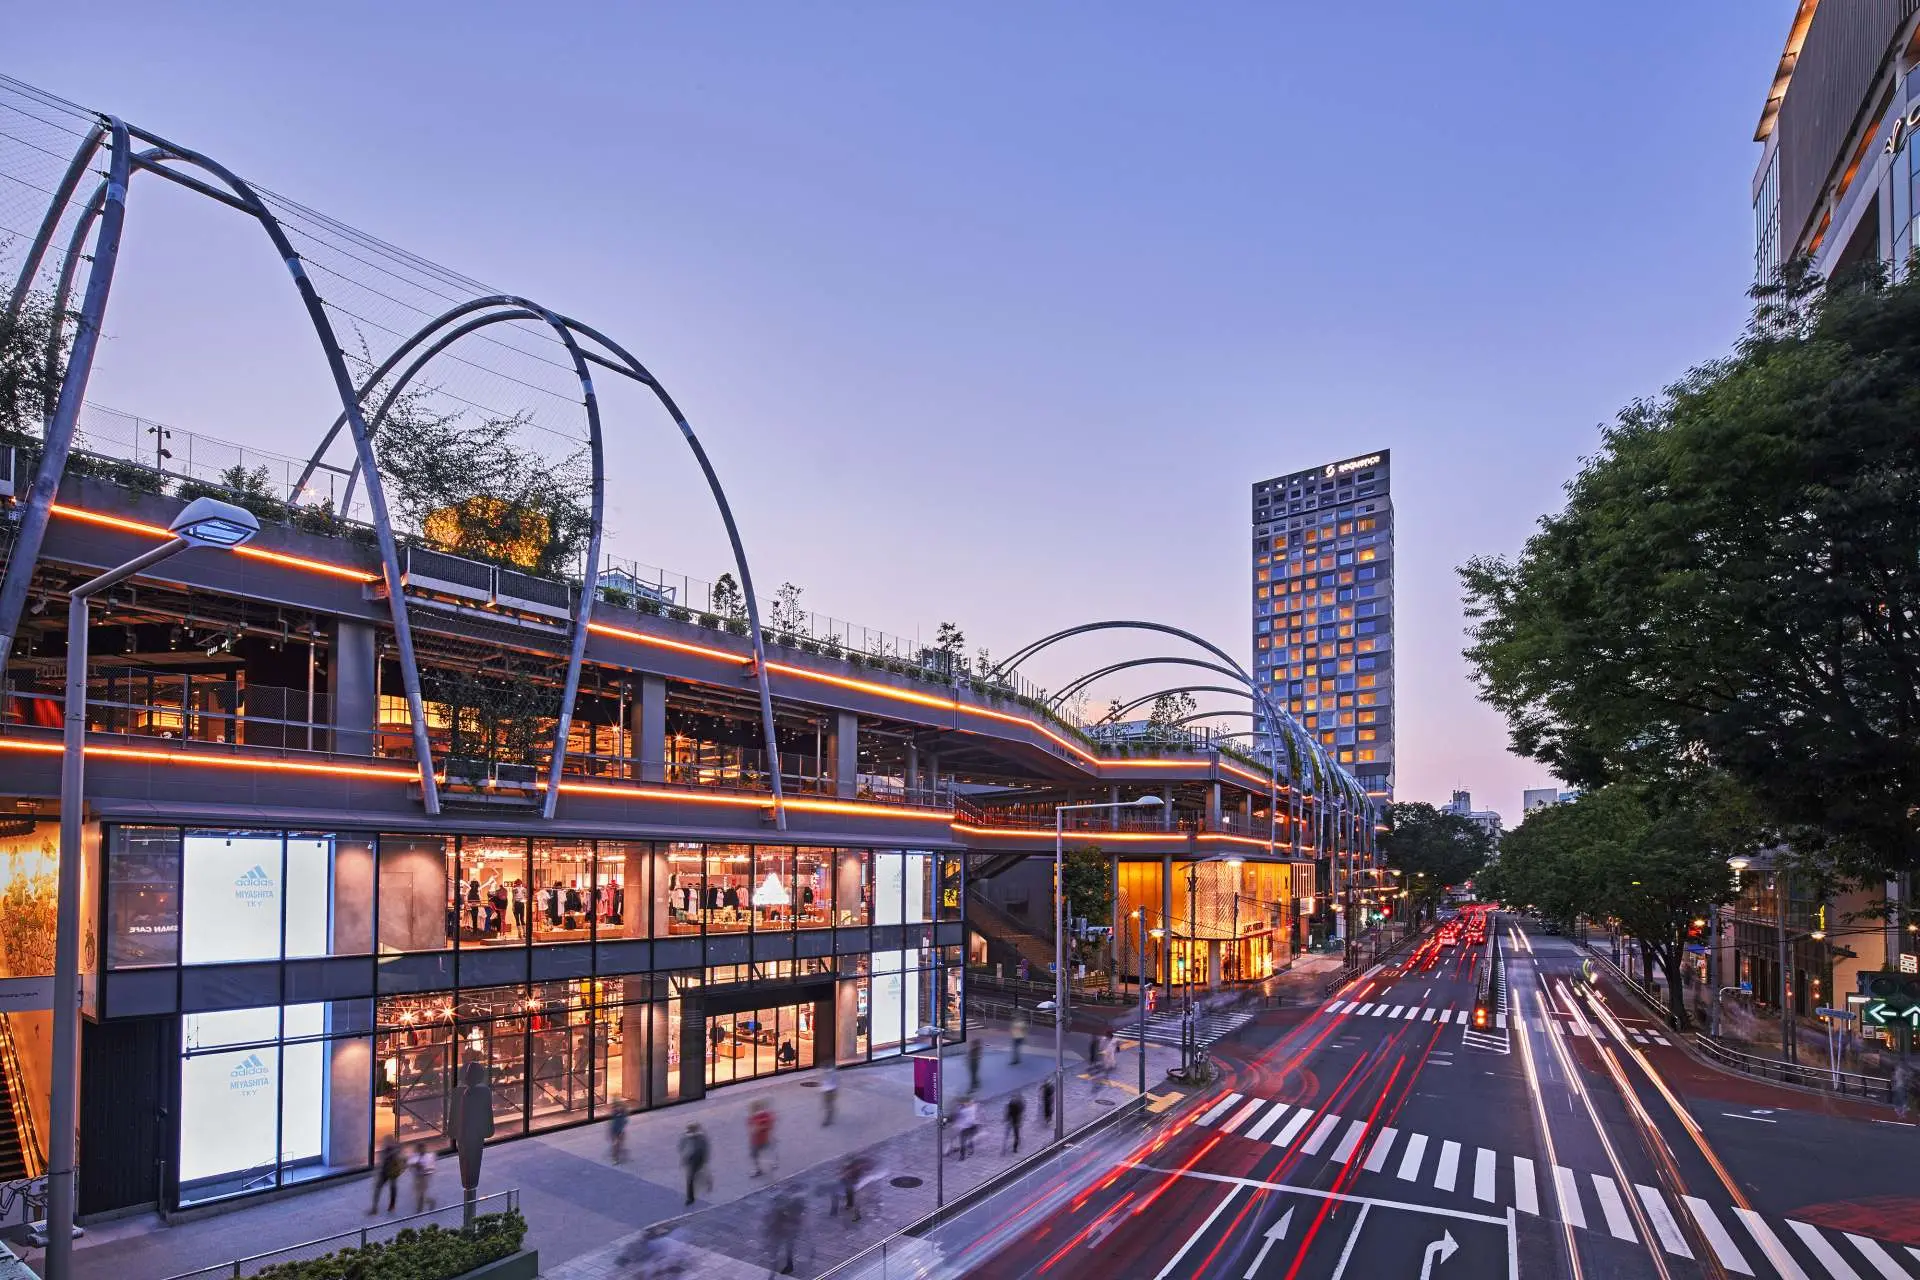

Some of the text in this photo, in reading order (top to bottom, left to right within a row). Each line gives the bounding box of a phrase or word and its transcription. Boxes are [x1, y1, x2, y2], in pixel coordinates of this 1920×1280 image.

[235, 878, 274, 887] adidas
[235, 890, 274, 899] MIYASHITA
[230, 1068, 269, 1077] adidas
[230, 1078, 269, 1090] MIYASHITA
